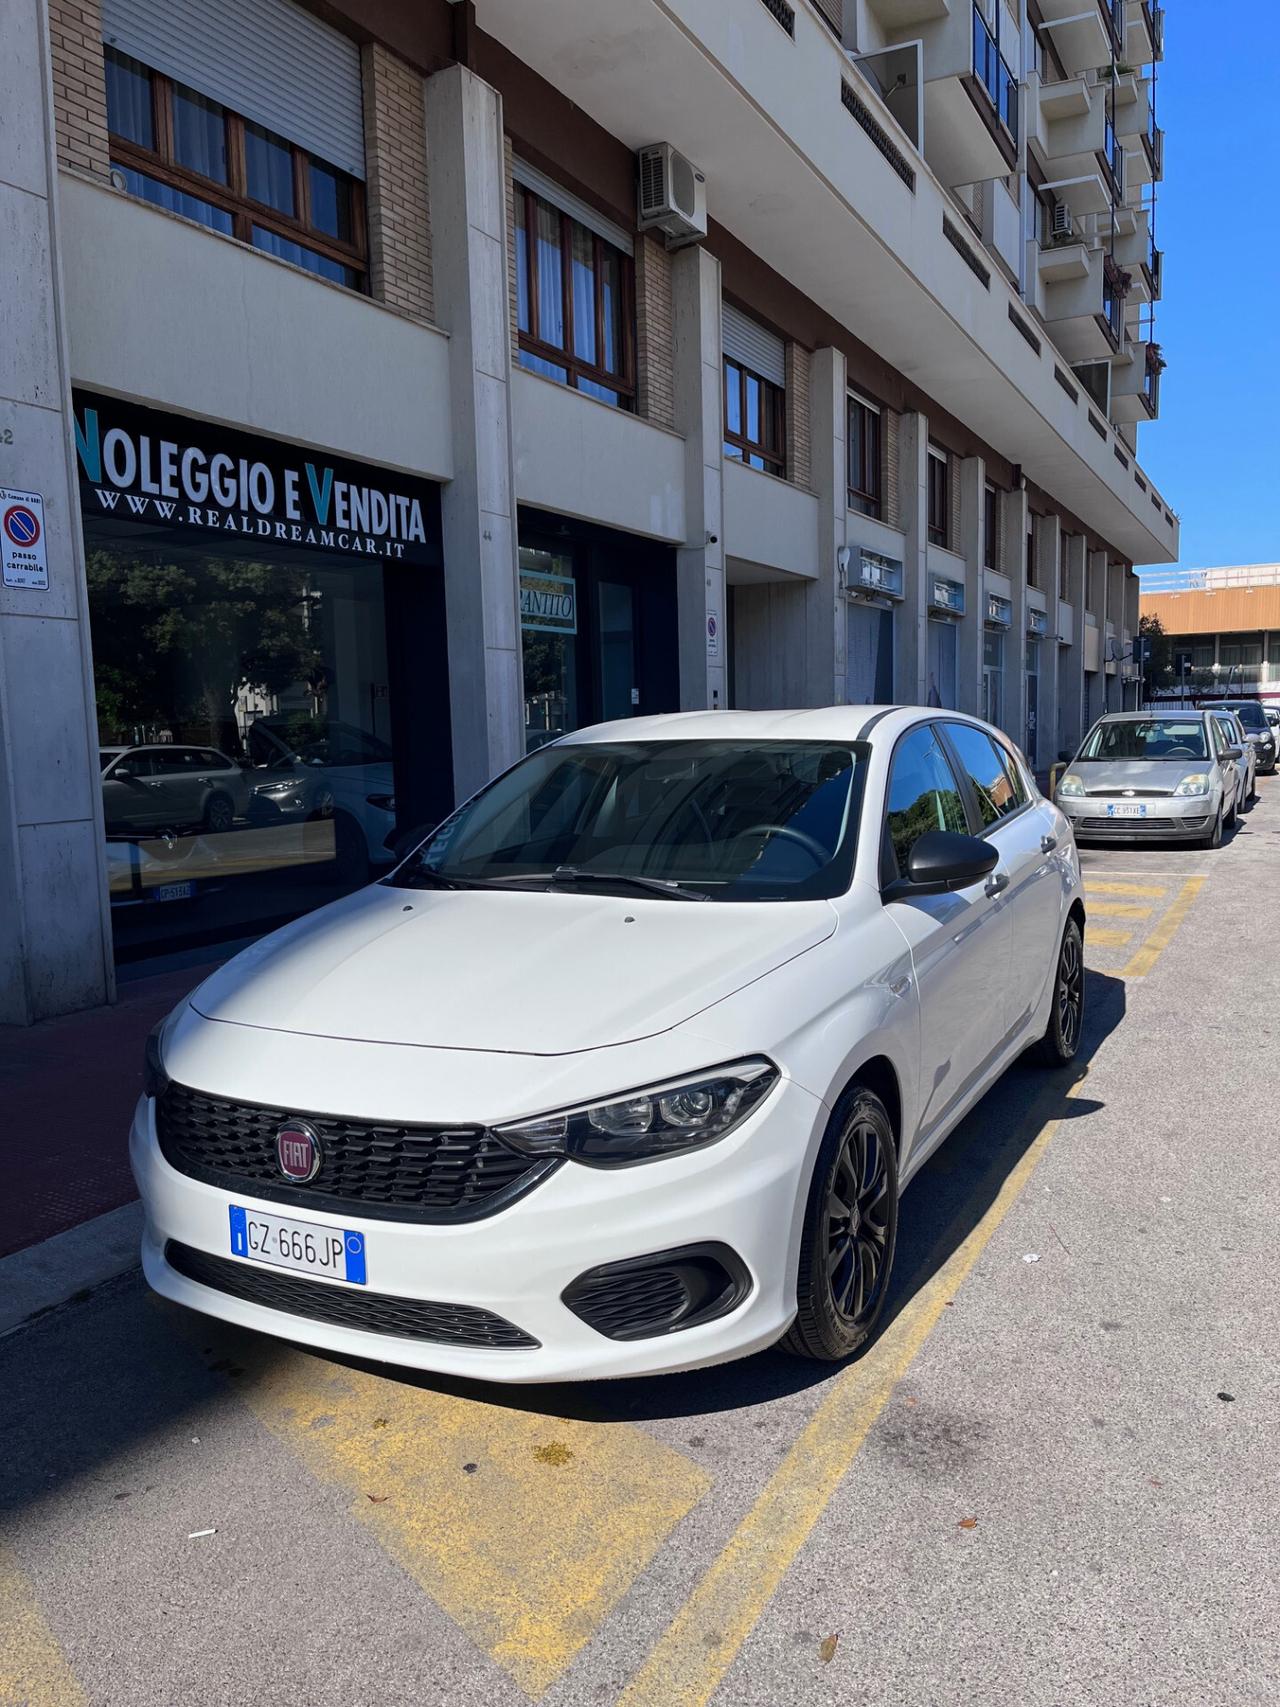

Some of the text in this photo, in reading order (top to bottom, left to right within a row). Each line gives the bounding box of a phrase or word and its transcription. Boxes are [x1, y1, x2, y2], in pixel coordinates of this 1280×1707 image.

[284, 469, 299, 520] E
[304, 462, 426, 544] VENDITA
[95, 488, 406, 559] WWW.REALDREAMCAR.IT
[6, 562, 44, 573] carrabile
[12, 551, 37, 561] passo
[283, 1140, 309, 1169] FIAT
[248, 1220, 271, 1255] GZ
